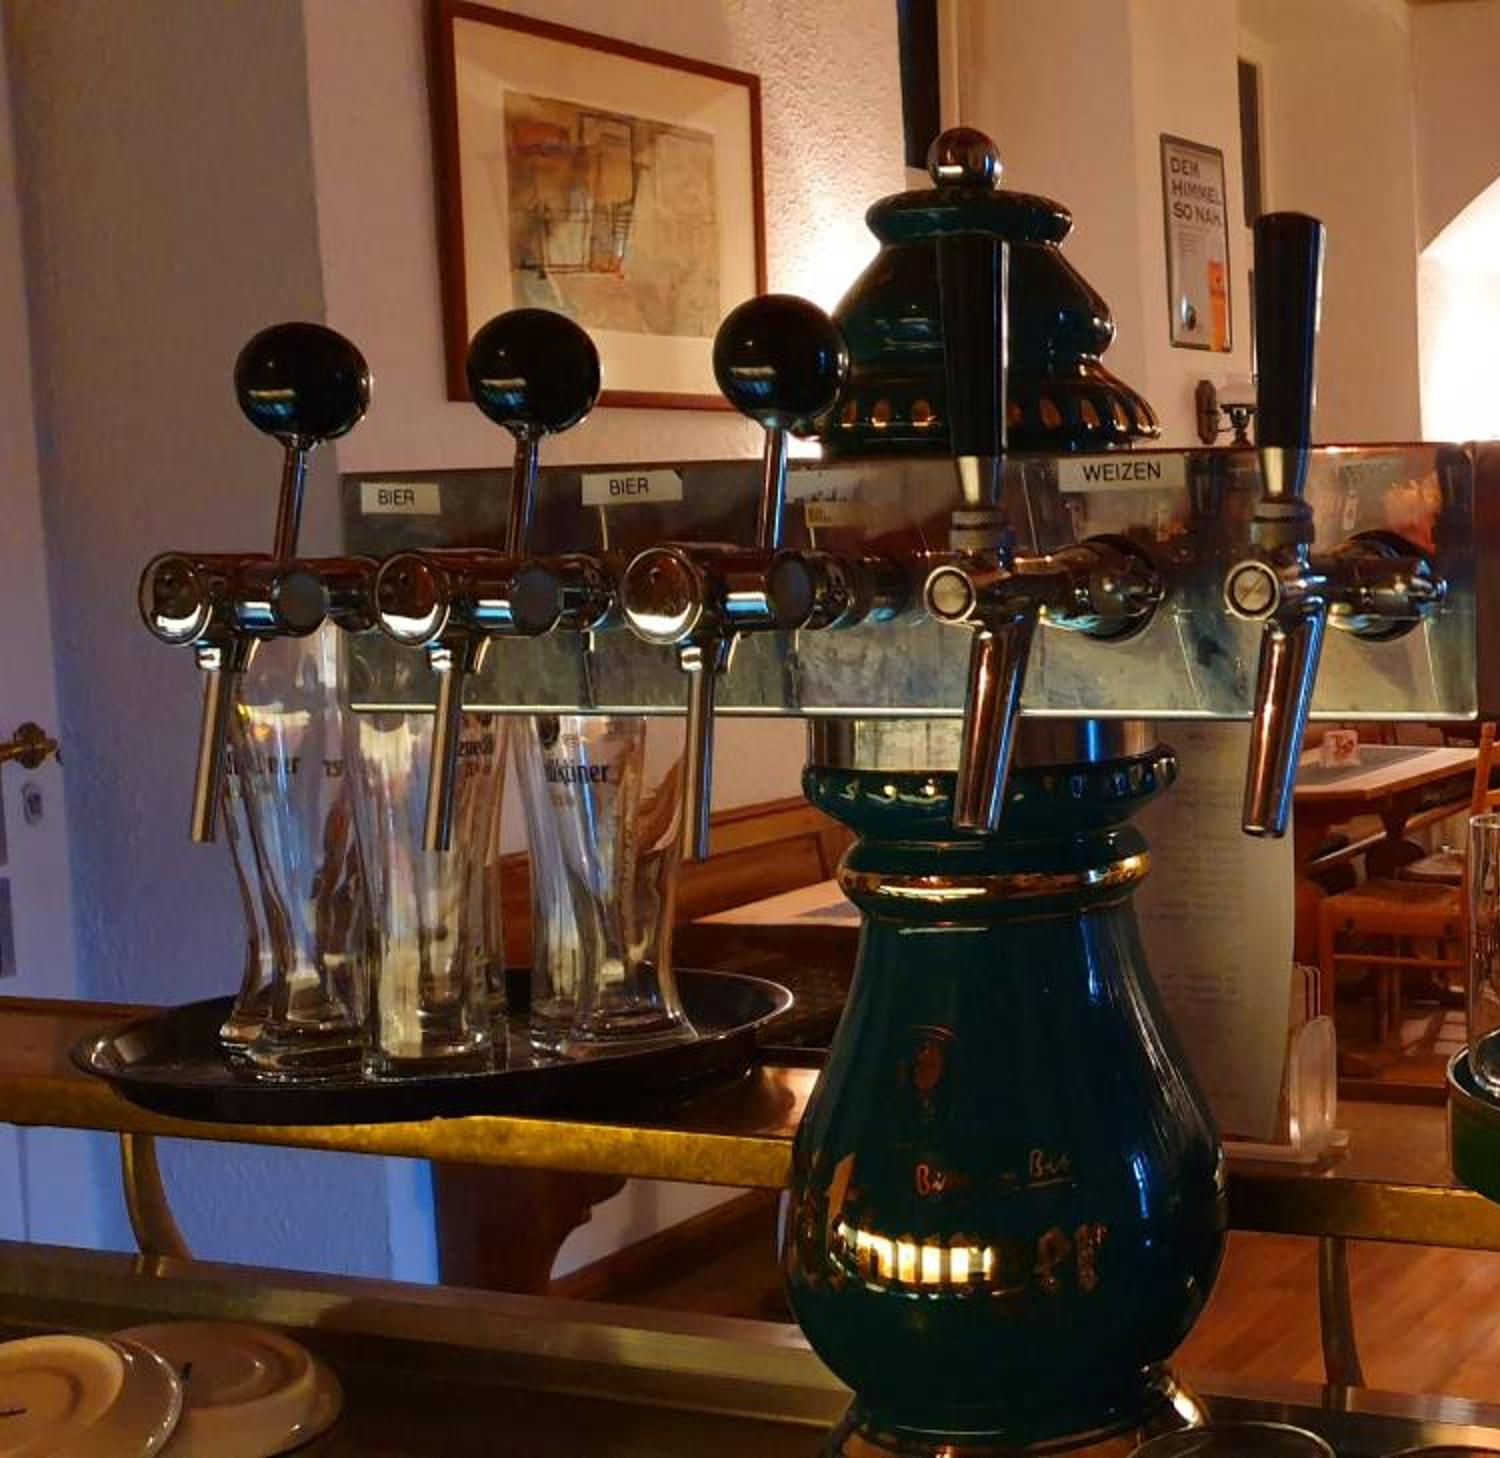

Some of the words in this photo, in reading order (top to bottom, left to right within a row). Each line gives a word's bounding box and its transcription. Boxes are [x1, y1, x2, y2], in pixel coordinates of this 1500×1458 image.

[1170, 156, 1199, 176] DEM
[1171, 179, 1222, 204] HIMMEL
[1173, 201, 1193, 221] SO
[1083, 462, 1161, 481] WEIZEN
[611, 477, 649, 496] BIER
[377, 488, 415, 506] BIER
